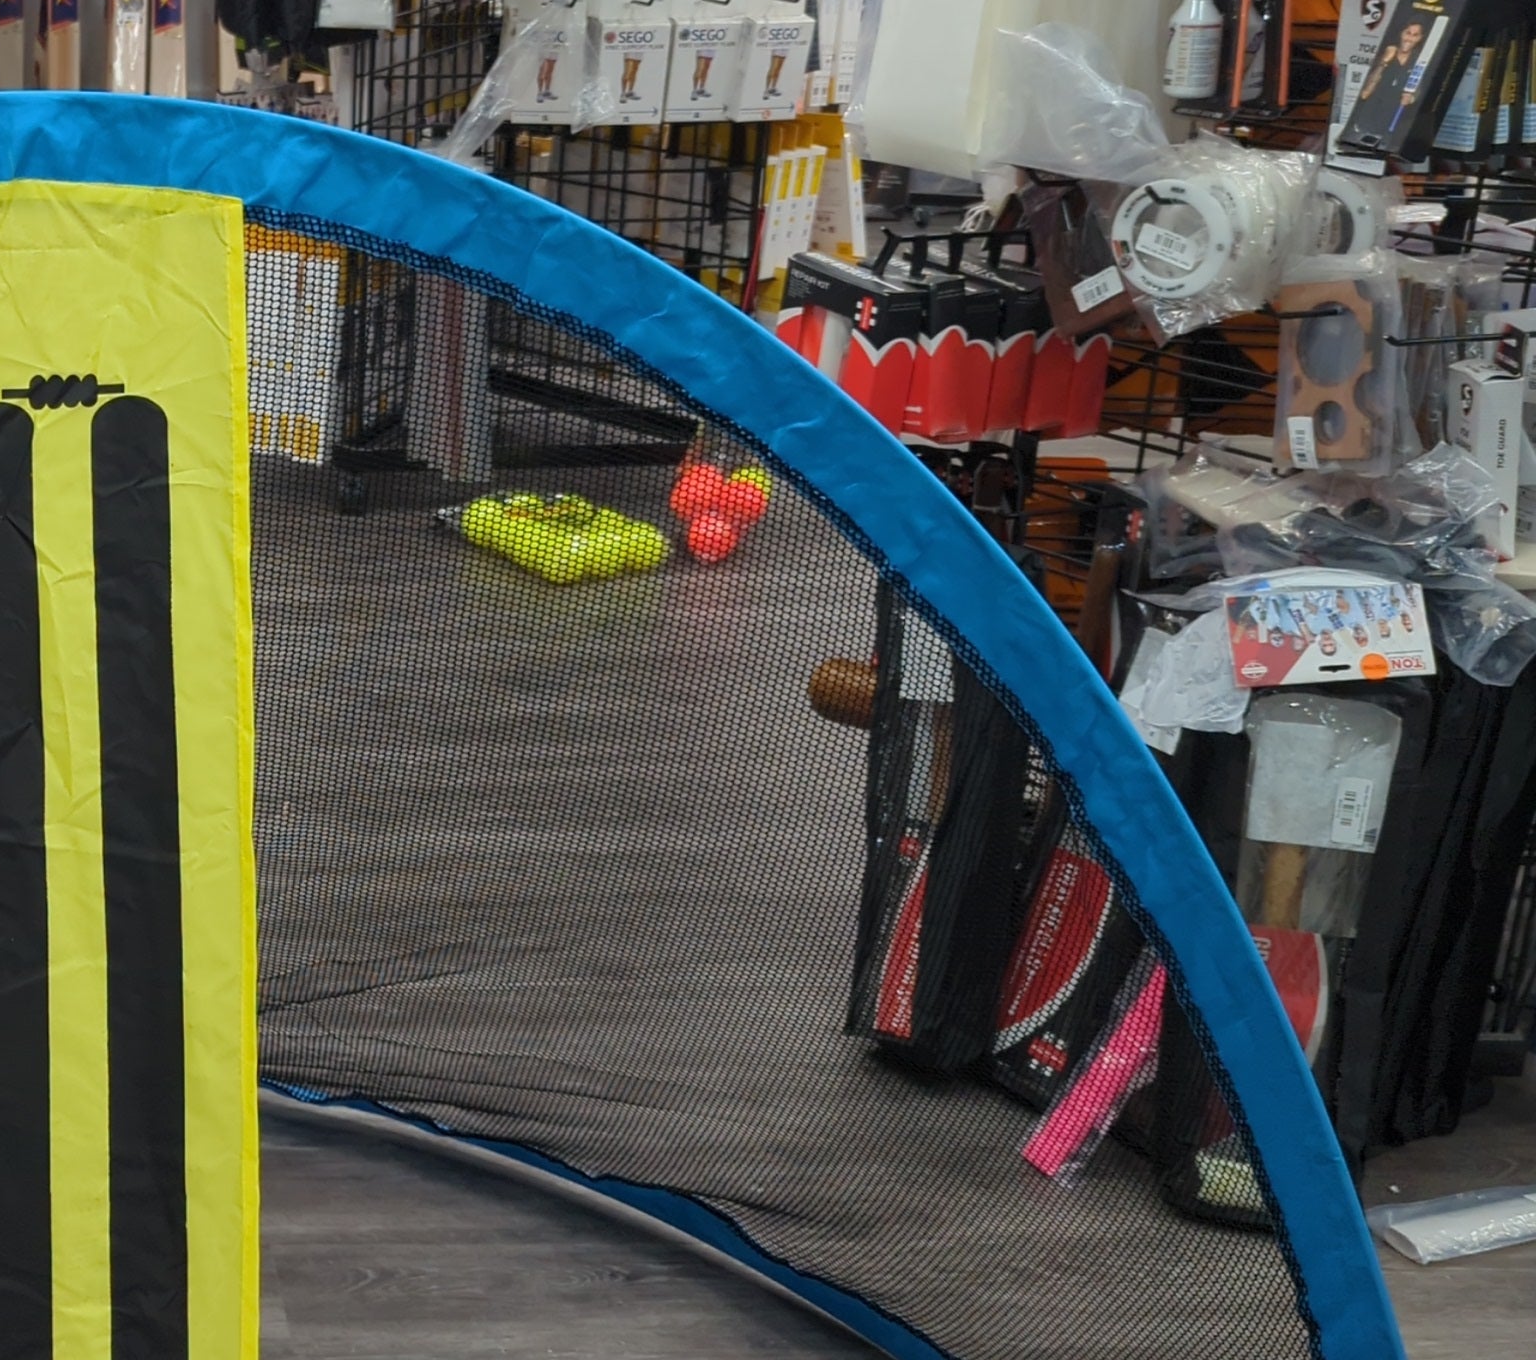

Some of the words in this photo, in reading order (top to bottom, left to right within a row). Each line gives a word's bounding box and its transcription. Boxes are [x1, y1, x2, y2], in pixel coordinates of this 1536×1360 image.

[618, 31, 653, 44] SEGO
[692, 28, 726, 41] SEGO
[768, 27, 800, 41] SEGO
[1498, 418, 1507, 449] GUARD
[1497, 452, 1506, 469] TOE
[1392, 654, 1422, 670] TON
